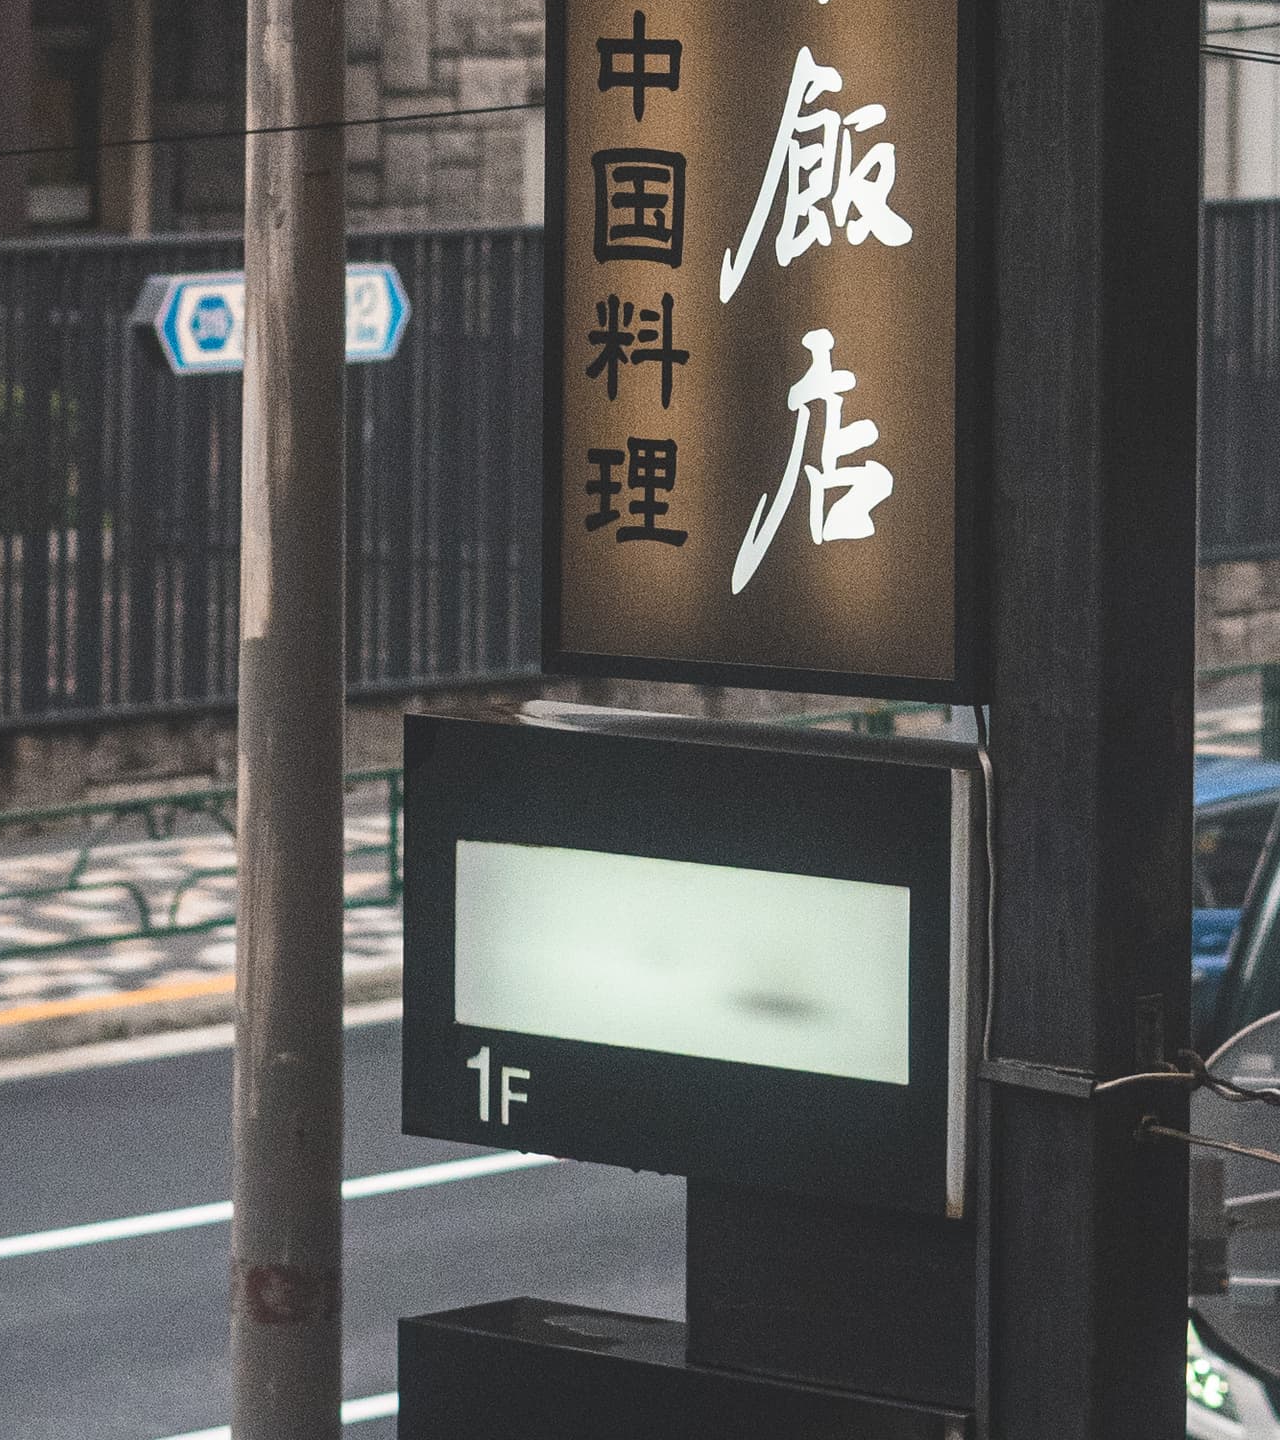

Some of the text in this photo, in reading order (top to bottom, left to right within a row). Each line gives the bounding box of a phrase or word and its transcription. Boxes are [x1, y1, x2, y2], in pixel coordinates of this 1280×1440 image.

[584, 9, 690, 548] 中国料理
[466, 1045, 531, 1126] 1F
